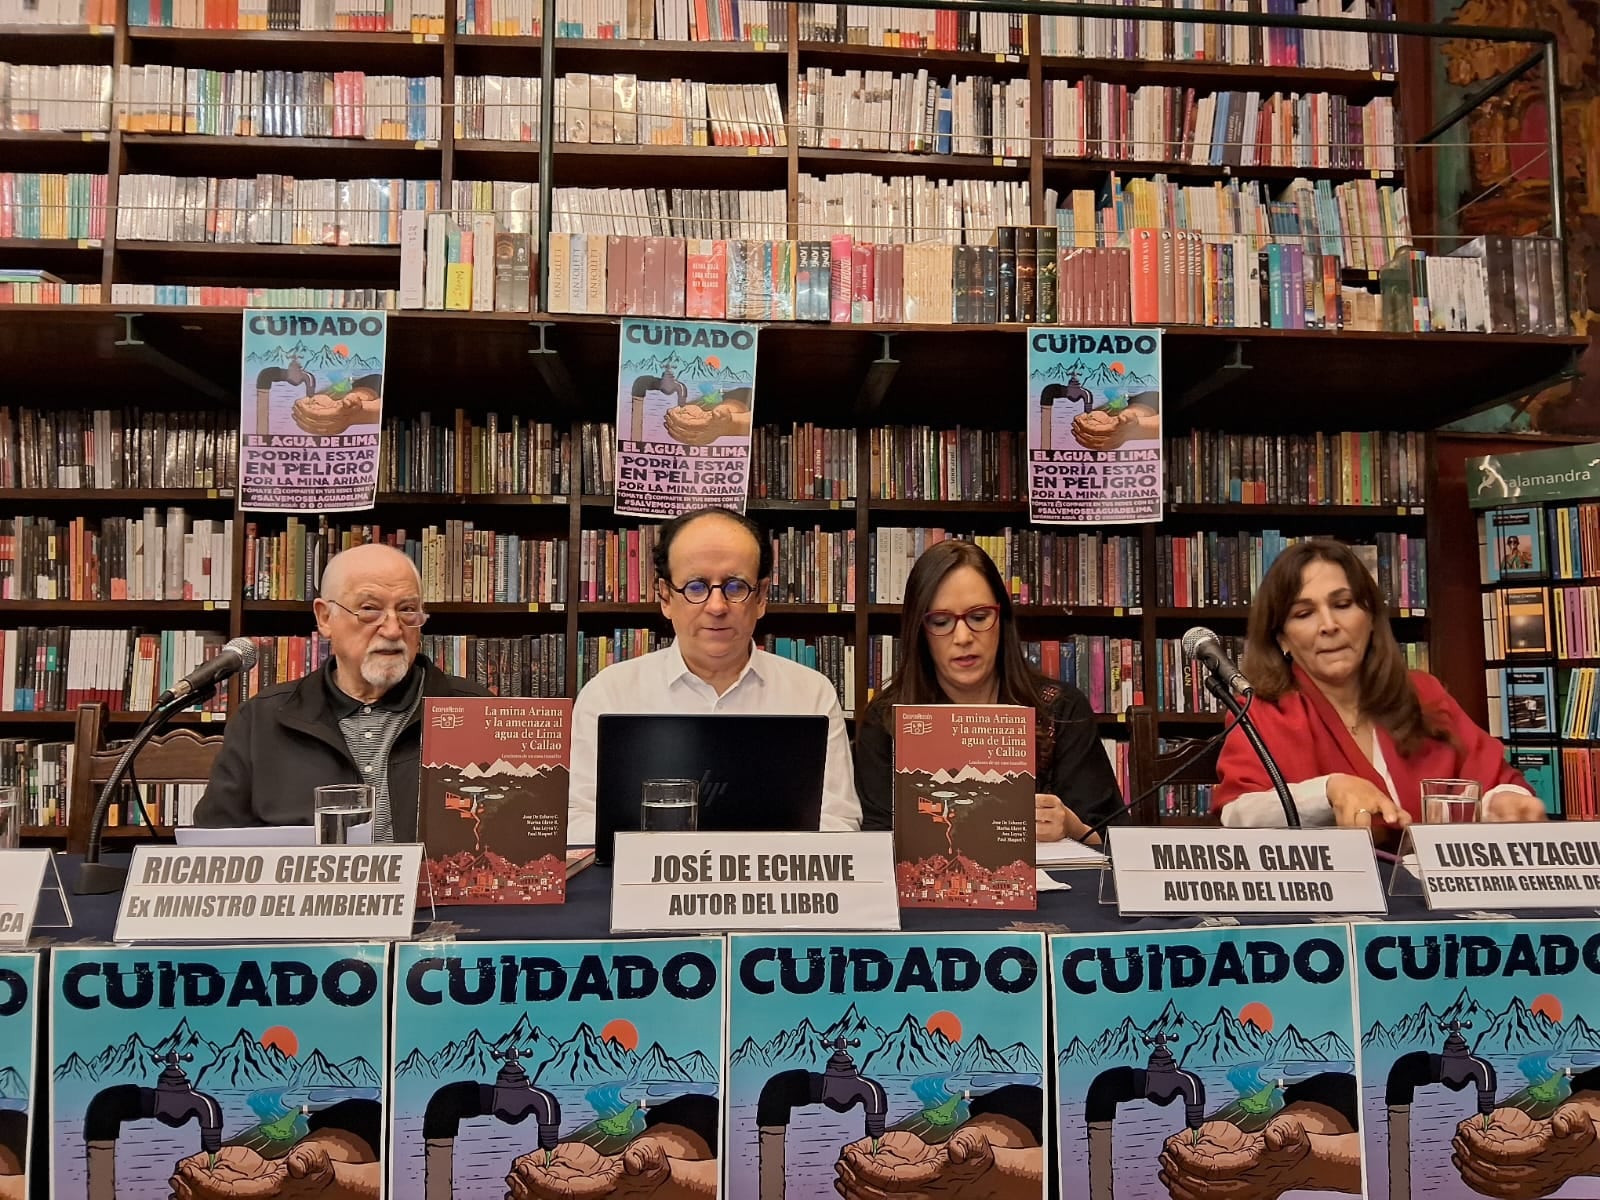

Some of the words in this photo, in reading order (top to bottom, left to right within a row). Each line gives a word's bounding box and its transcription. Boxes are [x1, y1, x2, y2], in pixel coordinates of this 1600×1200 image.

[250, 315, 383, 337] CUIDADO
[625, 324, 754, 350] CUIDADO
[1032, 333, 1157, 354] CUIDADO
[248, 436, 267, 447] EL
[271, 436, 317, 447] AGUA
[320, 436, 340, 447] DE
[343, 435, 377, 447] LIMA
[326, 450, 374, 461] ESTAR
[622, 441, 641, 453] EL
[644, 442, 686, 456] AGUA
[689, 446, 708, 457] DE
[712, 447, 747, 457] LIMA
[1033, 451, 1050, 461] EL
[1053, 451, 1094, 461] AGUA
[1097, 451, 1116, 461] DE
[1120, 449, 1158, 461] LIMA
[246, 462, 275, 475] EN
[282, 461, 374, 475] PELIGRO
[695, 461, 744, 471] ESTAR
[1103, 464, 1156, 475] ESTAR
[244, 476, 272, 485] POR
[297, 477, 330, 486] MINA
[333, 475, 374, 485] ARIANA
[621, 467, 647, 481] EN
[653, 470, 744, 485] PELIGRO
[1033, 476, 1057, 489] EN
[1063, 475, 1157, 489] PELIGRO
[618, 481, 645, 491] POR
[648, 483, 663, 492] LA
[667, 485, 698, 494] MINA
[701, 486, 744, 495] ARIANA
[1032, 490, 1055, 498] POR
[1059, 491, 1072, 499] LA
[1076, 491, 1106, 499] MINA
[1111, 489, 1158, 498] ARIANA
[485, 706, 497, 716] La
[500, 706, 526, 716] mina
[529, 706, 563, 717] Ariana
[951, 713, 963, 723] La
[966, 713, 991, 723] mina
[994, 713, 1026, 724] Ariana
[485, 719, 492, 729] y
[494, 717, 503, 727] la
[506, 719, 551, 728] amenaza
[553, 717, 563, 728] al
[952, 726, 958, 736] y
[960, 724, 969, 734] la
[972, 726, 1015, 735] amenaza
[1017, 724, 1026, 735] al
[494, 731, 519, 740] agua
[521, 729, 534, 739] de
[536, 728, 562, 739] Lima
[521, 742, 528, 752] y
[529, 740, 562, 750] Callao
[961, 737, 984, 747] agua
[987, 736, 999, 745] de
[1001, 736, 1026, 746] Lima
[988, 749, 994, 758] y
[996, 746, 1027, 757] Callao
[1151, 844, 1251, 870] MARISA
[1259, 844, 1334, 871] GLAVE
[1435, 841, 1501, 868] LUISA
[142, 855, 264, 884] RICARDO
[274, 854, 404, 883] GIESECKE
[652, 849, 713, 883] JOSÉ
[719, 854, 752, 882] DE
[757, 853, 855, 882] ECHAVE
[1428, 875, 1518, 893] SECRETARIA
[1518, 874, 1583, 892] GENERAL
[1164, 881, 1241, 901] AUTORA
[1242, 881, 1276, 901] DEL
[1279, 881, 1334, 901] LIBRO
[126, 895, 151, 918] Ex
[152, 894, 256, 918] MINISTRO
[260, 894, 296, 917] DEL
[299, 894, 405, 916] AMBIENTE
[668, 893, 738, 916] AUTOR
[742, 893, 776, 916] DEL
[780, 892, 839, 915] LIBRO
[738, 946, 1038, 996] CUIDADO
[1062, 938, 1345, 995] CUIDADO
[62, 957, 378, 1010] CUIDADO
[405, 951, 717, 1006] CUIDADO
